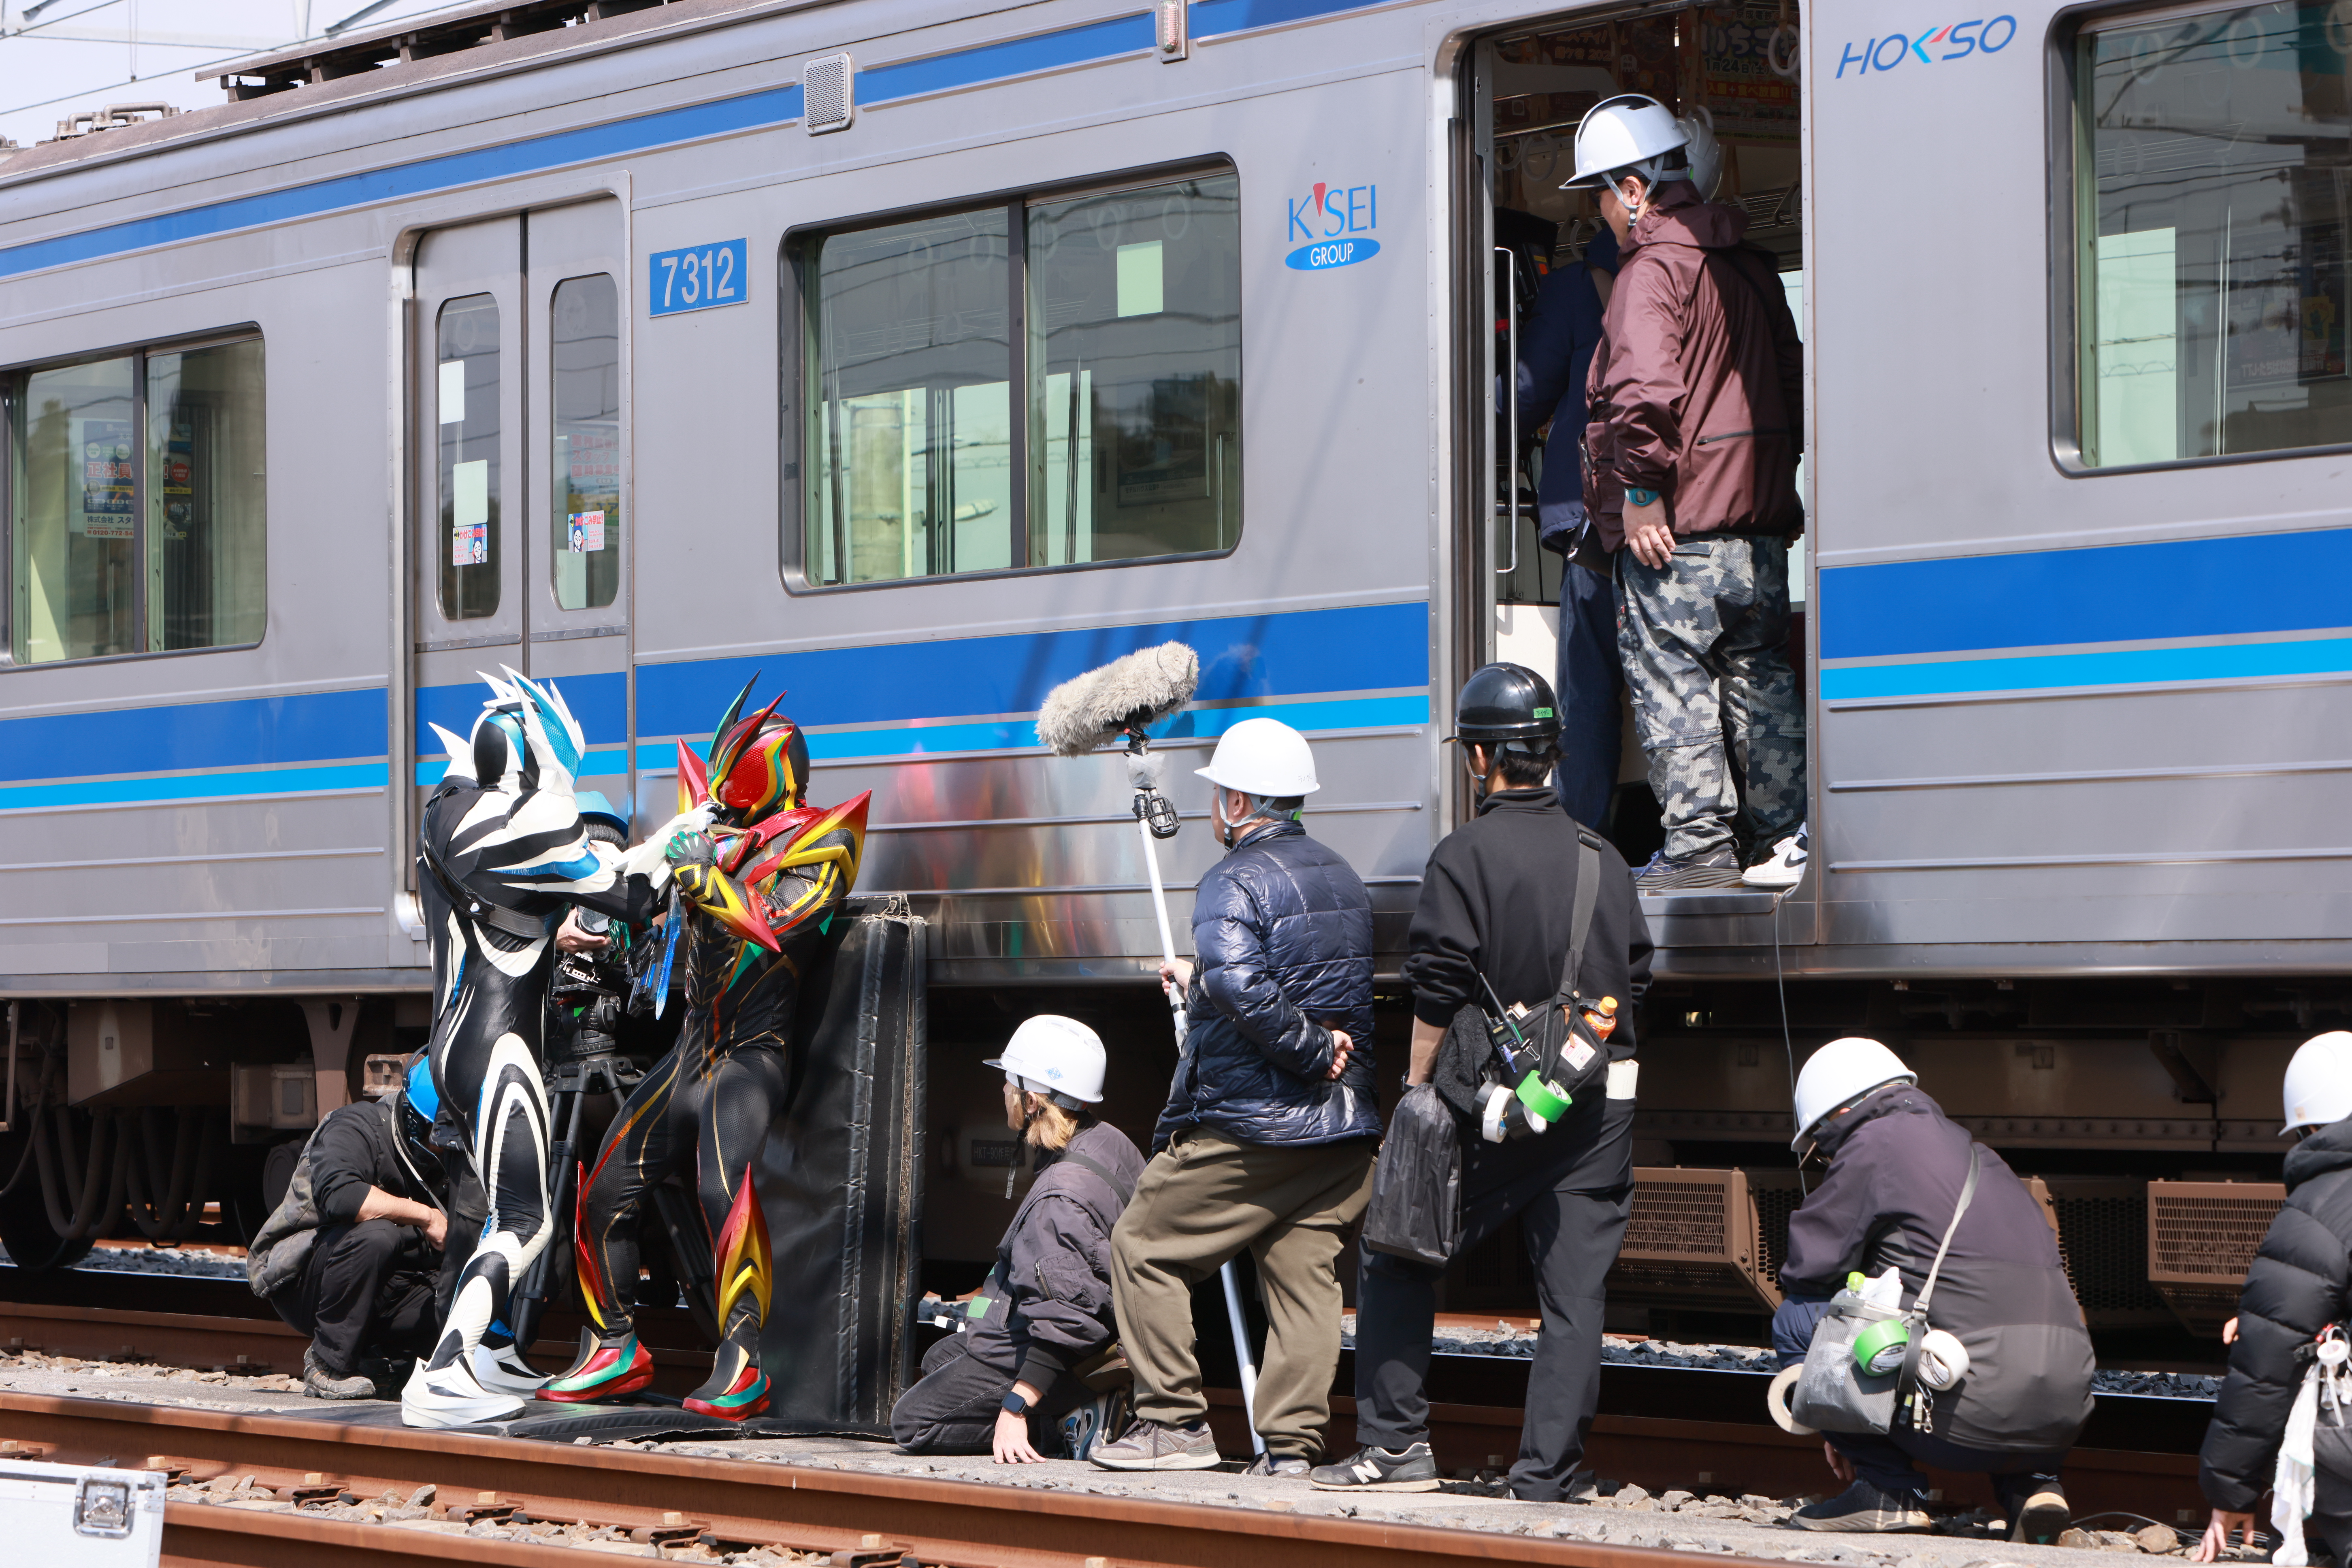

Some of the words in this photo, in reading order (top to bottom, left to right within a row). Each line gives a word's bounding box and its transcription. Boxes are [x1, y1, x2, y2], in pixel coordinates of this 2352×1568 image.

[1588, 49, 1611, 62] 202
[1310, 243, 1353, 268] GROUP
[660, 247, 734, 307] 7312
[572, 450, 610, 462] スタッフ
[87, 462, 132, 479] 正社員
[575, 513, 603, 526] かけこみ禁止!
[460, 527, 486, 539] かけこみ禁止!
[1297, 773, 1313, 784] ライダー
[1351, 1459, 1382, 1484] N
